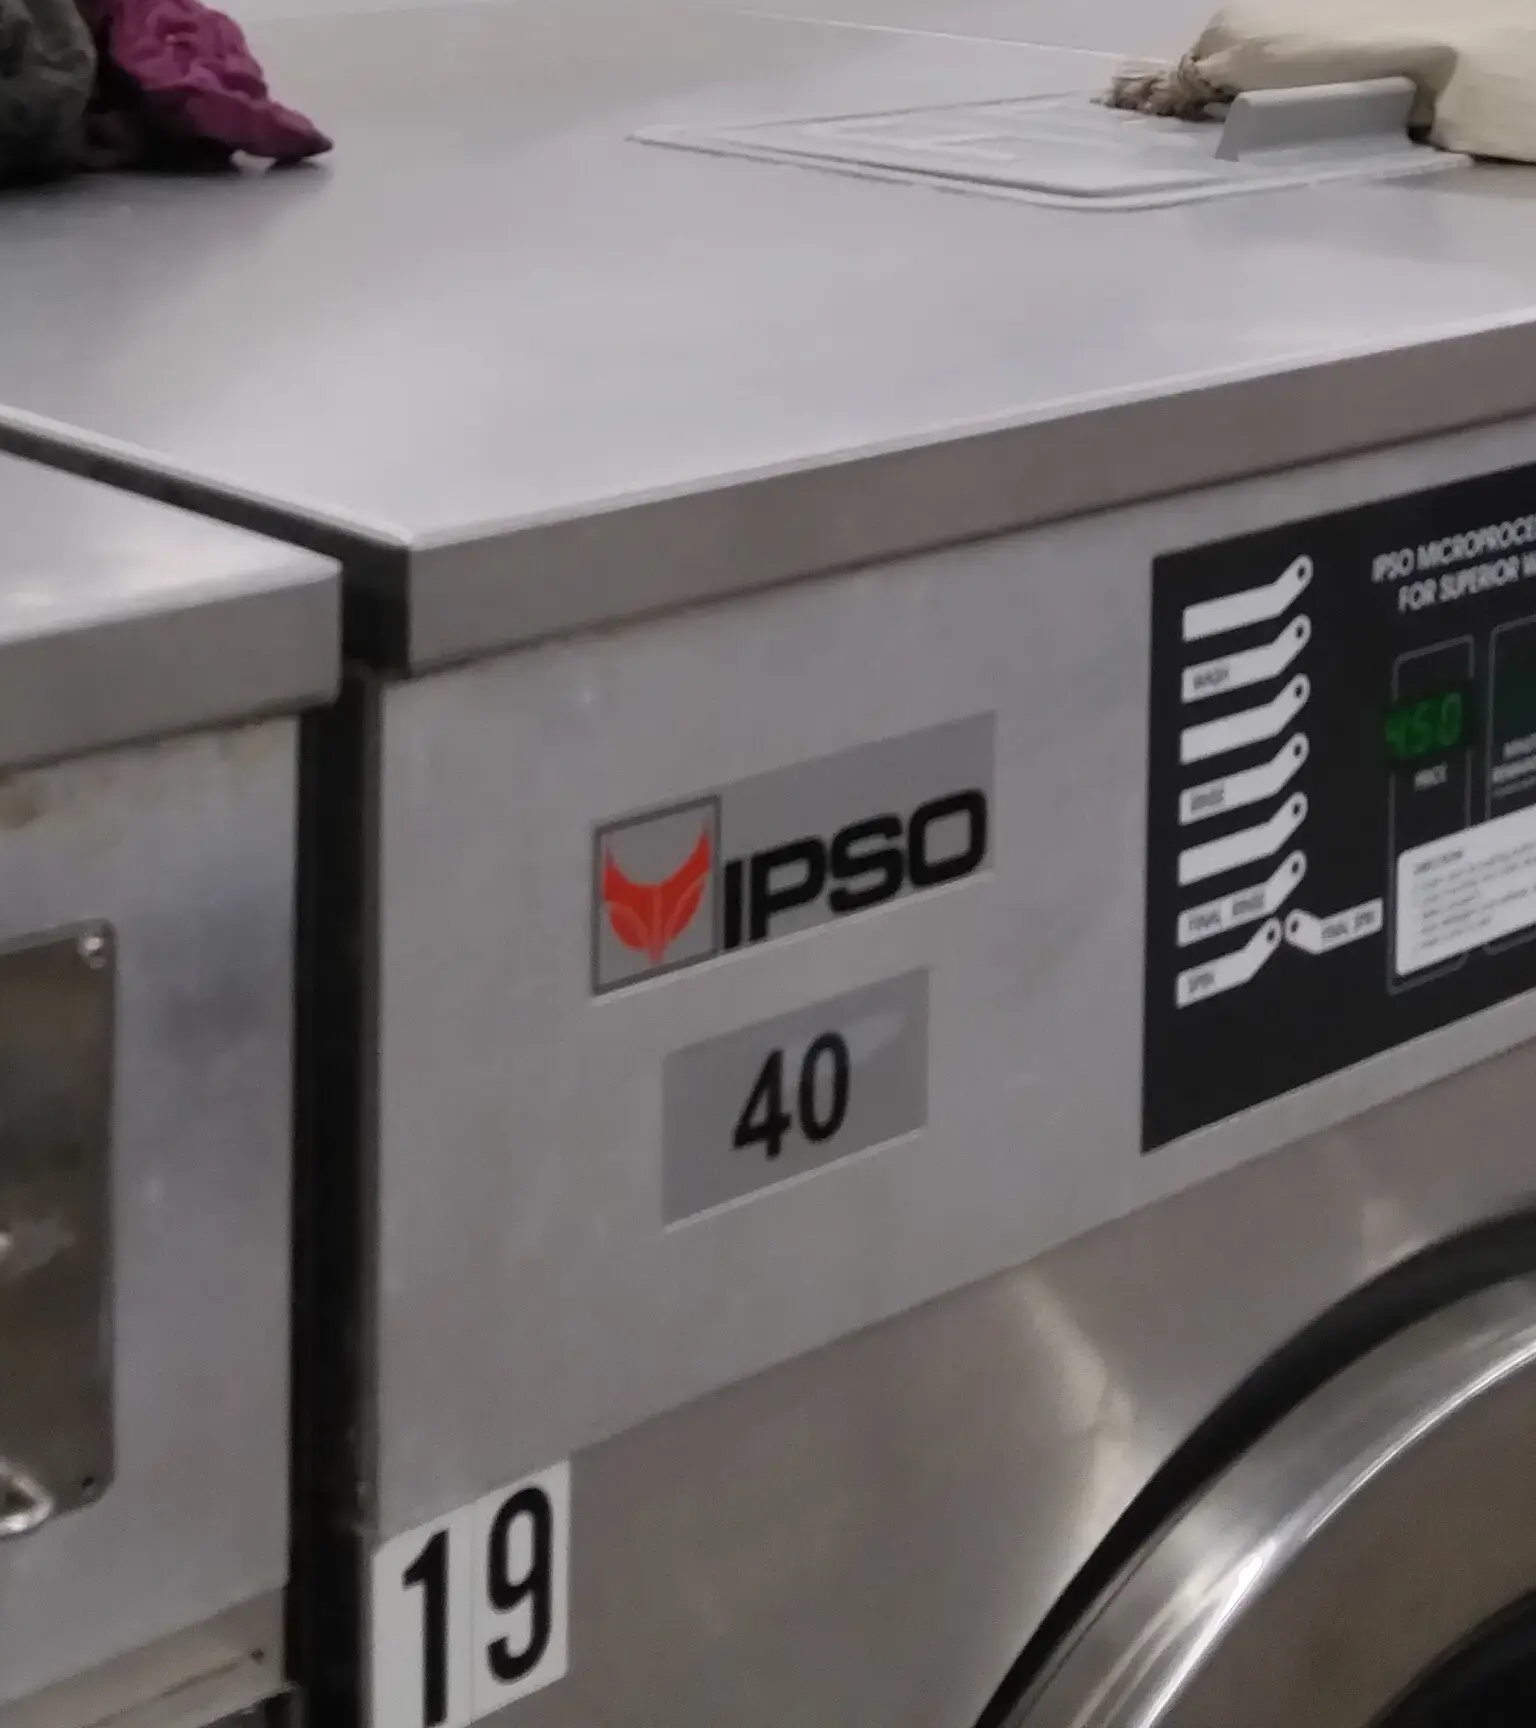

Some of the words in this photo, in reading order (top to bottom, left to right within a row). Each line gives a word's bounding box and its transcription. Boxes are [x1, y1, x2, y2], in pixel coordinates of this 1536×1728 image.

[723, 788, 987, 950] IPSO
[732, 1031, 851, 1160] 40
[402, 1486, 553, 1727] 19
